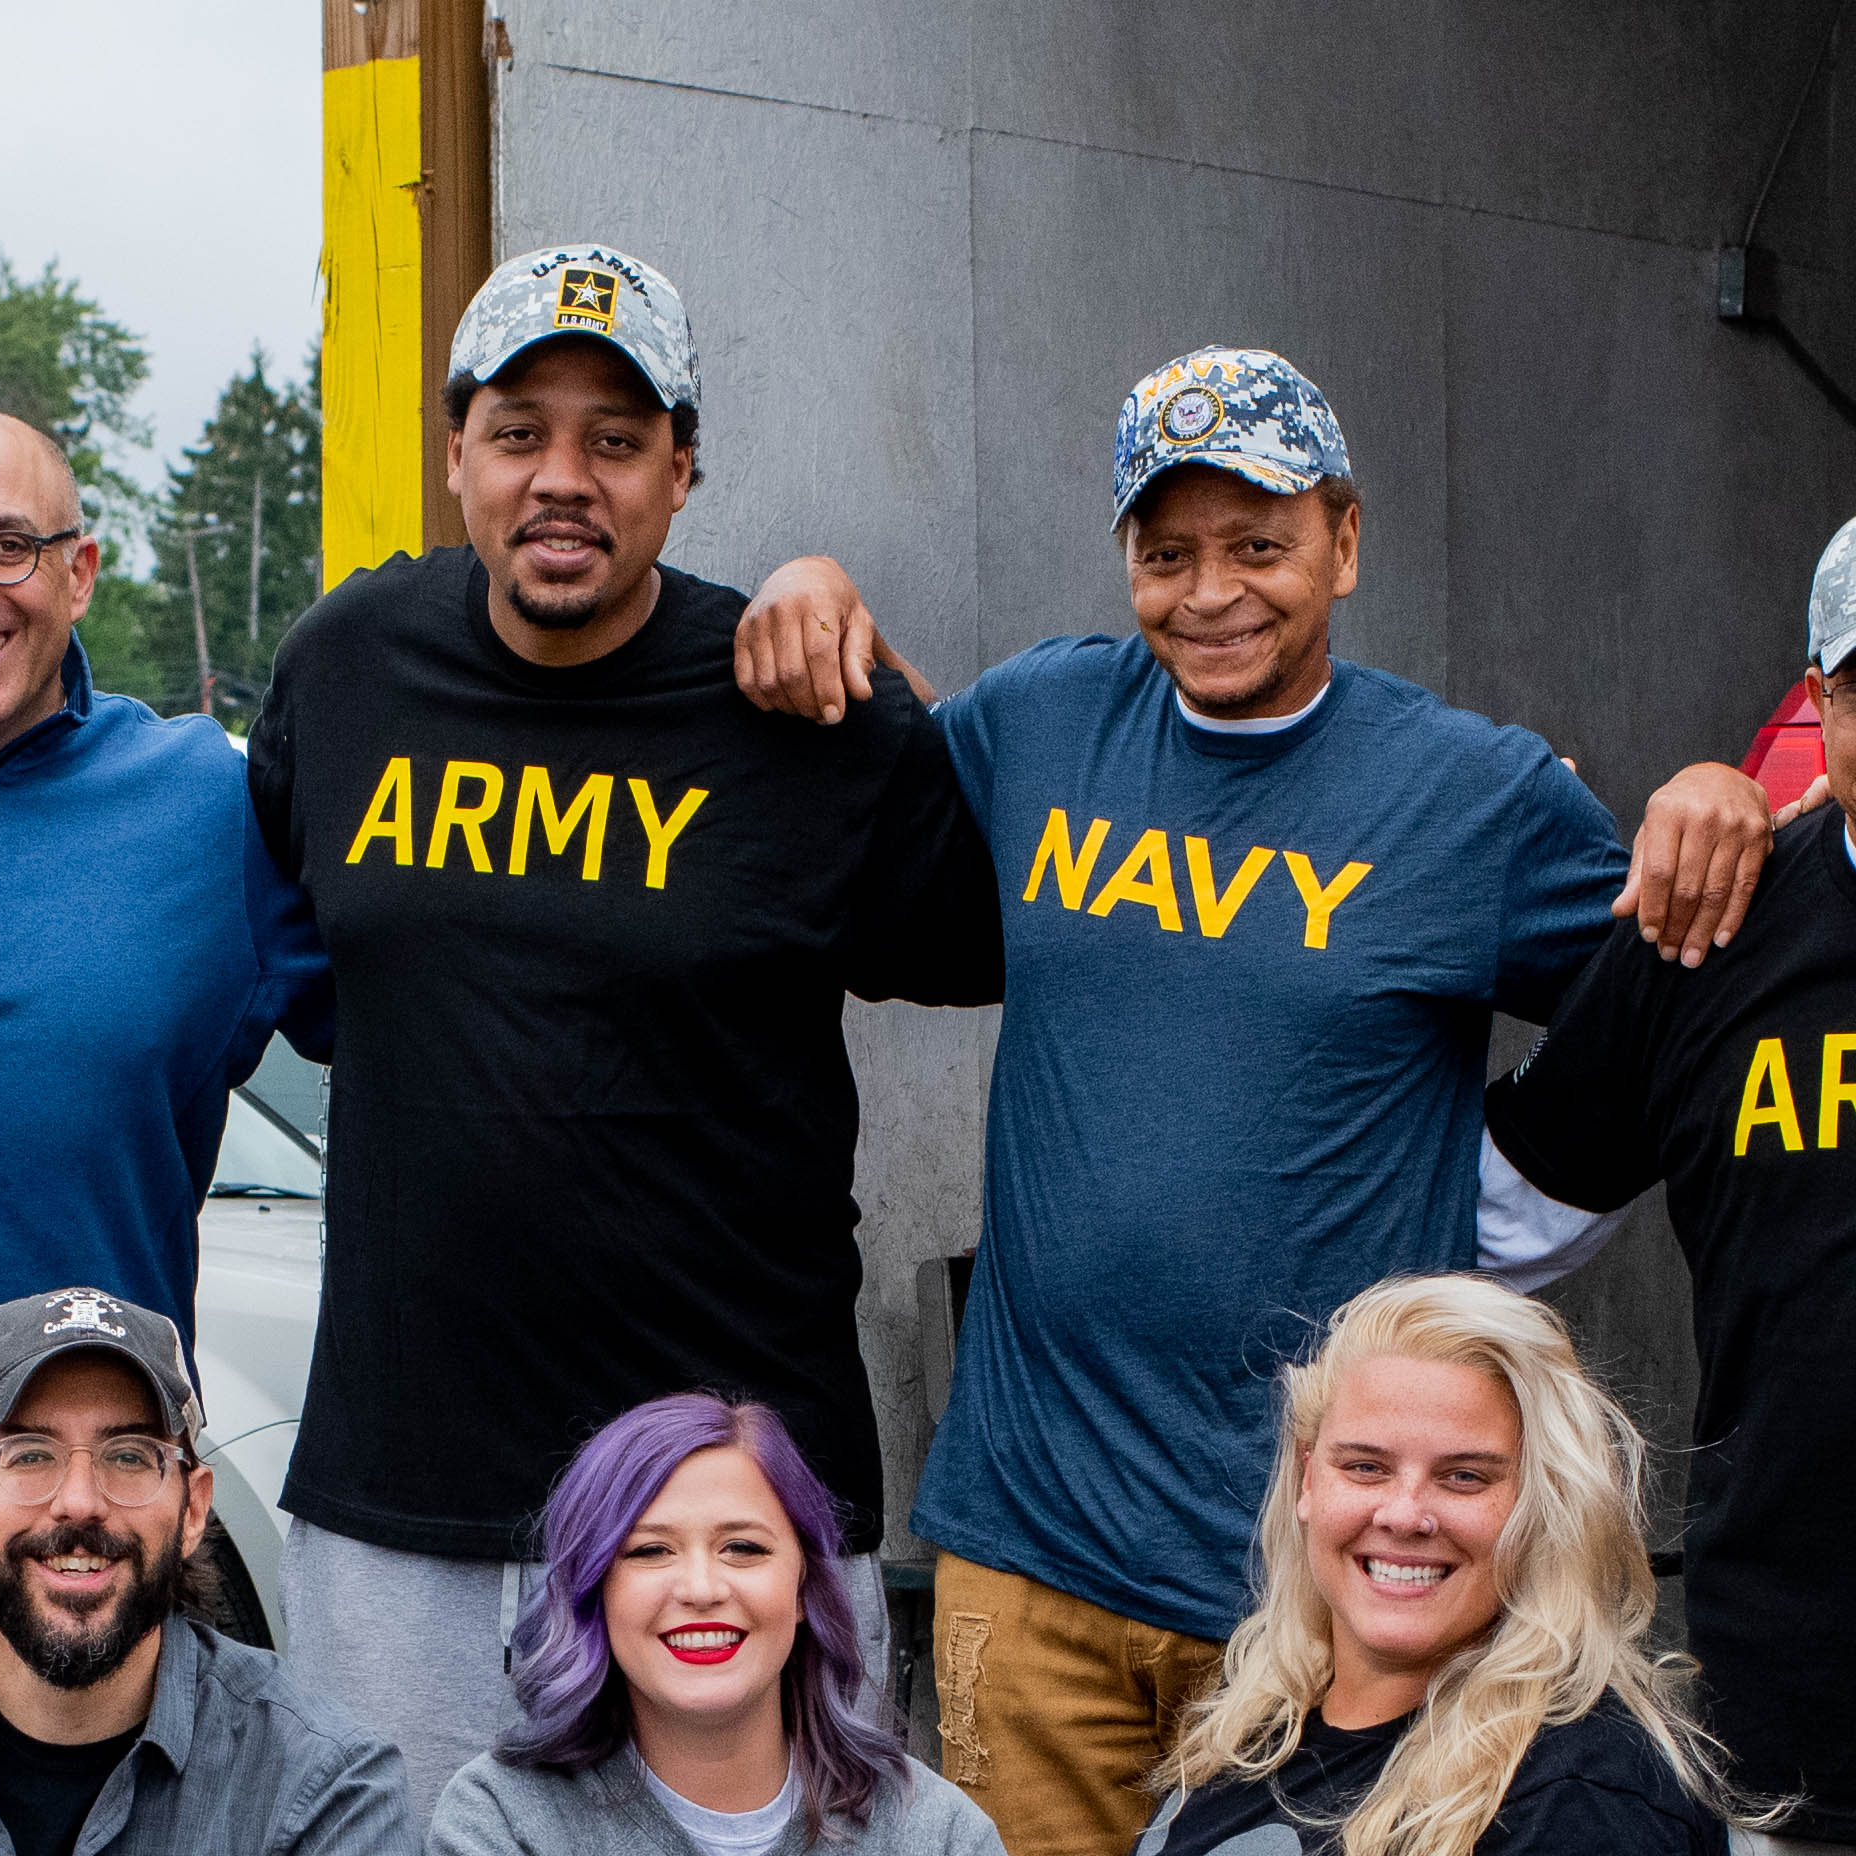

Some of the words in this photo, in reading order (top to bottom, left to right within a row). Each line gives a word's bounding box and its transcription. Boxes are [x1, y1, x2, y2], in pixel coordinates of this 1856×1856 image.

[587, 249, 648, 297] ARMY
[1142, 358, 1245, 408] NAVY
[347, 758, 707, 888] ARMY
[1024, 809, 1369, 947] NAVY
